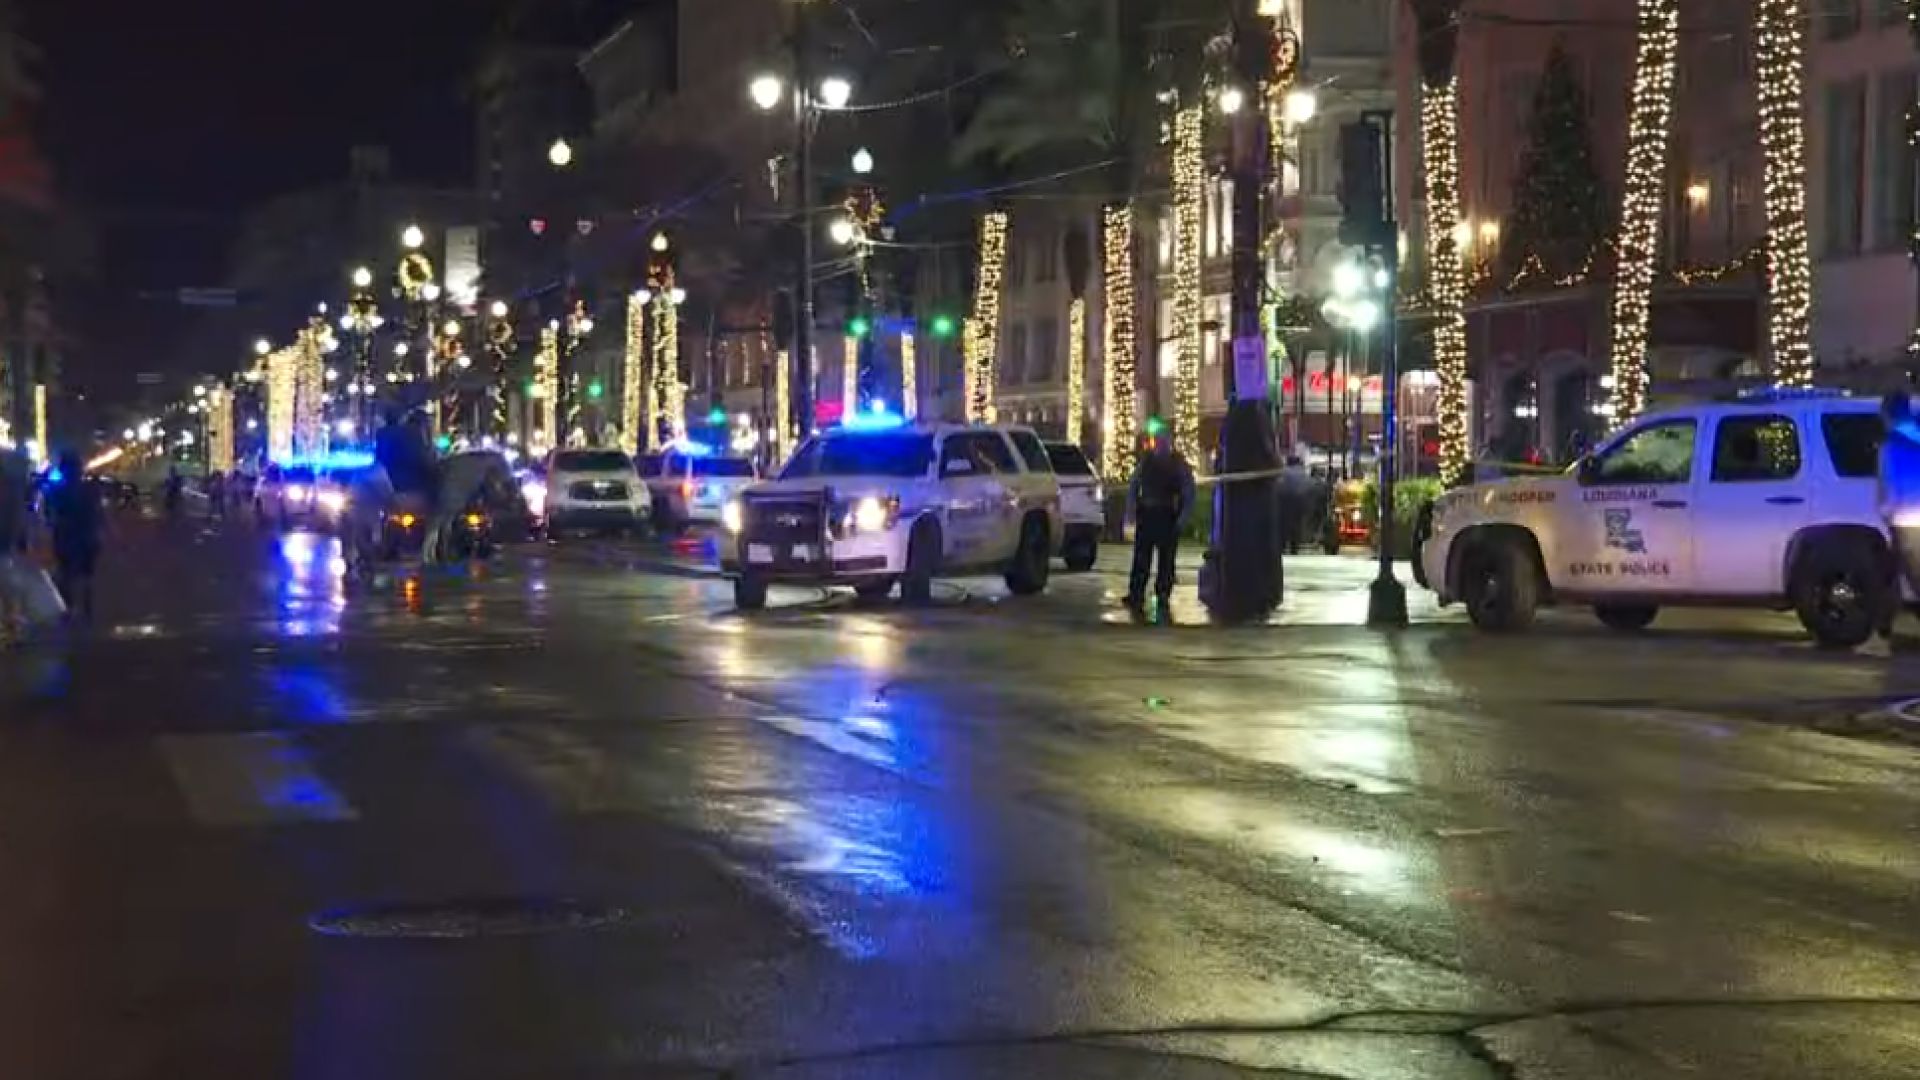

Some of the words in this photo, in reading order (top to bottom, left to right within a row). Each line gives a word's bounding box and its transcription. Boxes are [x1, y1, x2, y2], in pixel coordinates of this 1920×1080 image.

[1583, 487, 1657, 501] LOUISIANA
[1569, 562, 1612, 576] STATE
[1620, 561, 1669, 577] POLICE
